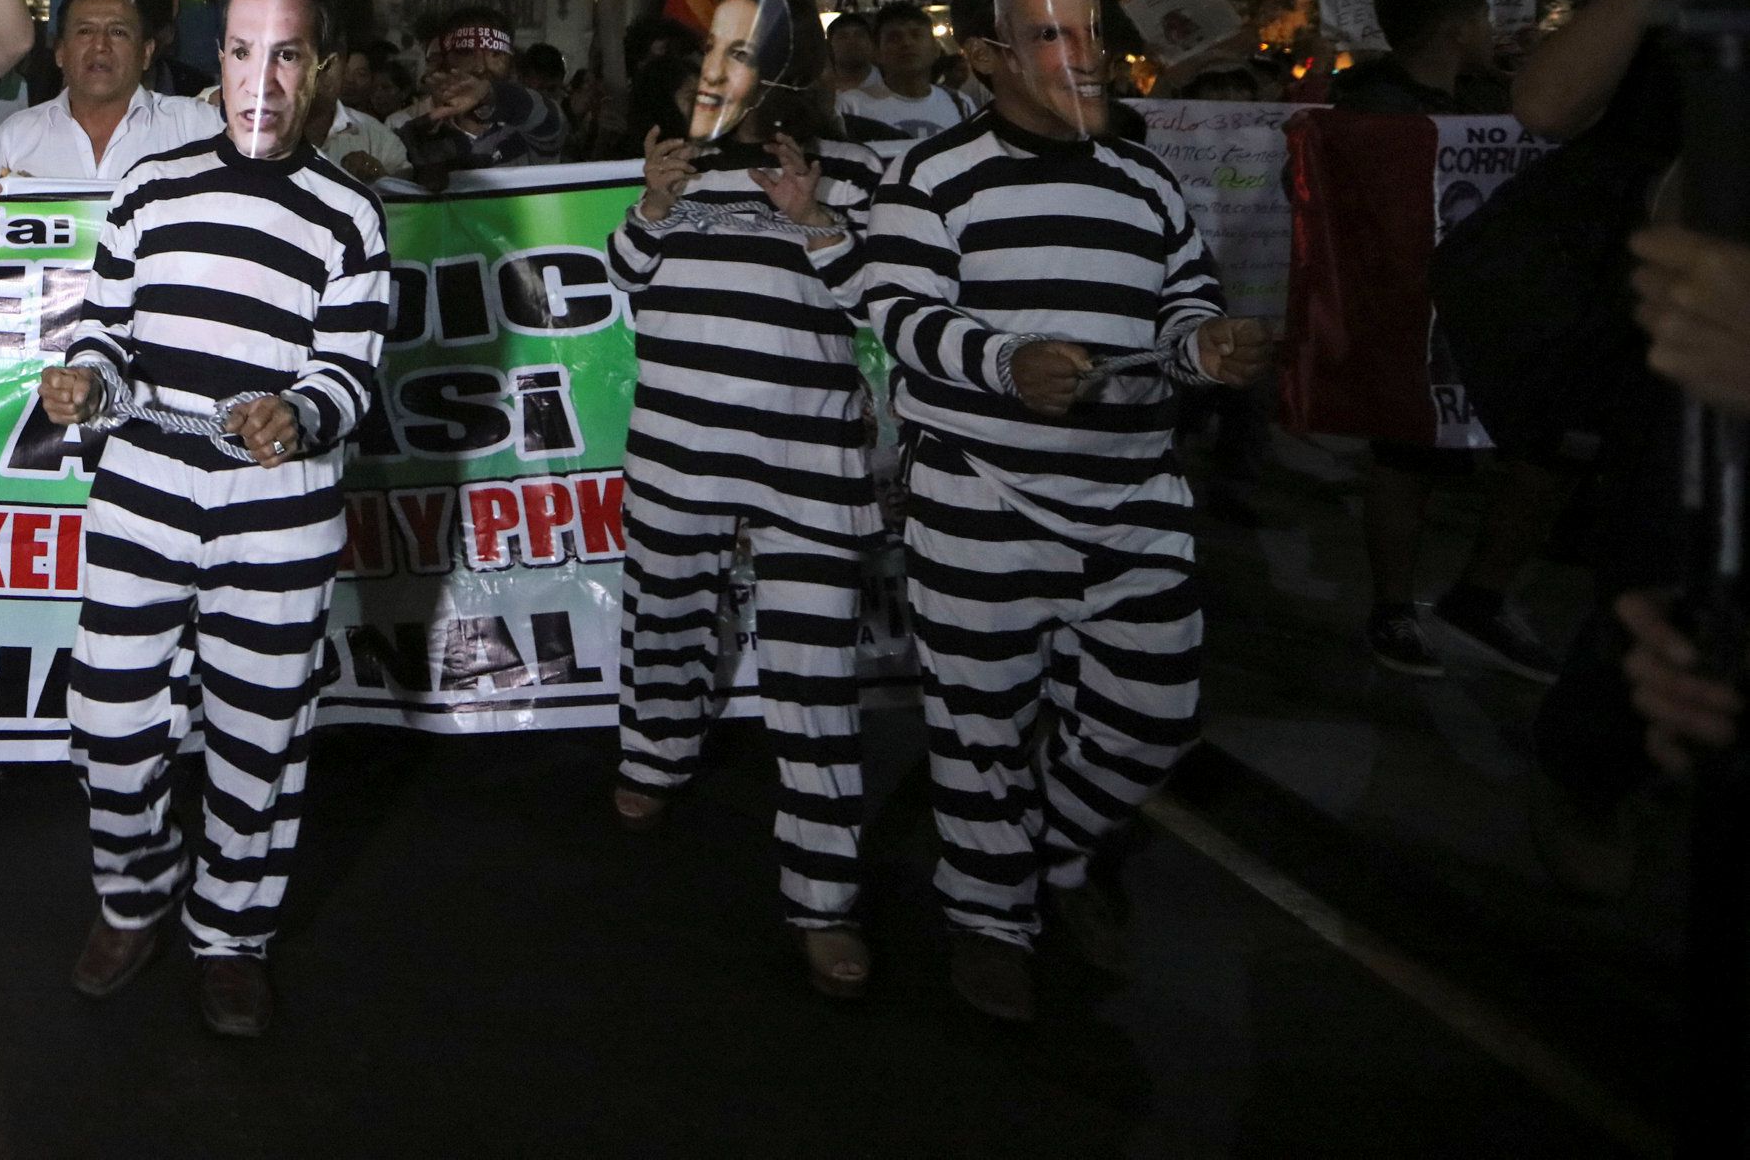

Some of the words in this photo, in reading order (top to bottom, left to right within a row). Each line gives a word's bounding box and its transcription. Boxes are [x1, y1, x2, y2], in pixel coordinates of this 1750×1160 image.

[1466, 127, 1506, 144] NO
[396, 492, 447, 568] Y
[467, 477, 627, 562] PPK
